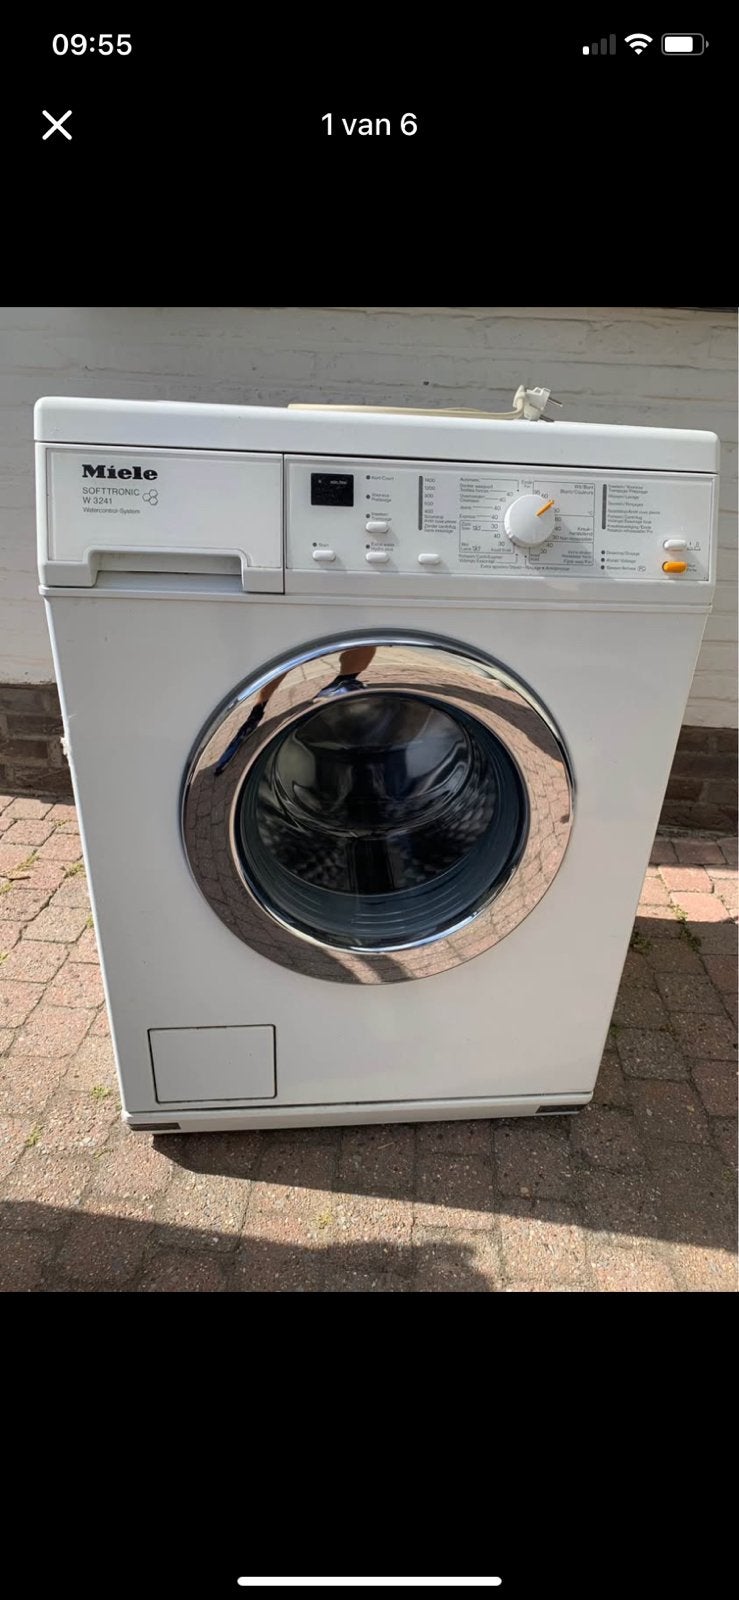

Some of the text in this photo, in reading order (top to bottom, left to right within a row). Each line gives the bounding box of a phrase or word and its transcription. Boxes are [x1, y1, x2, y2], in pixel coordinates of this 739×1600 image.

[81, 464, 158, 480] Miele
[82, 487, 140, 496] SOFTTRONIC
[93, 497, 113, 505] 3241
